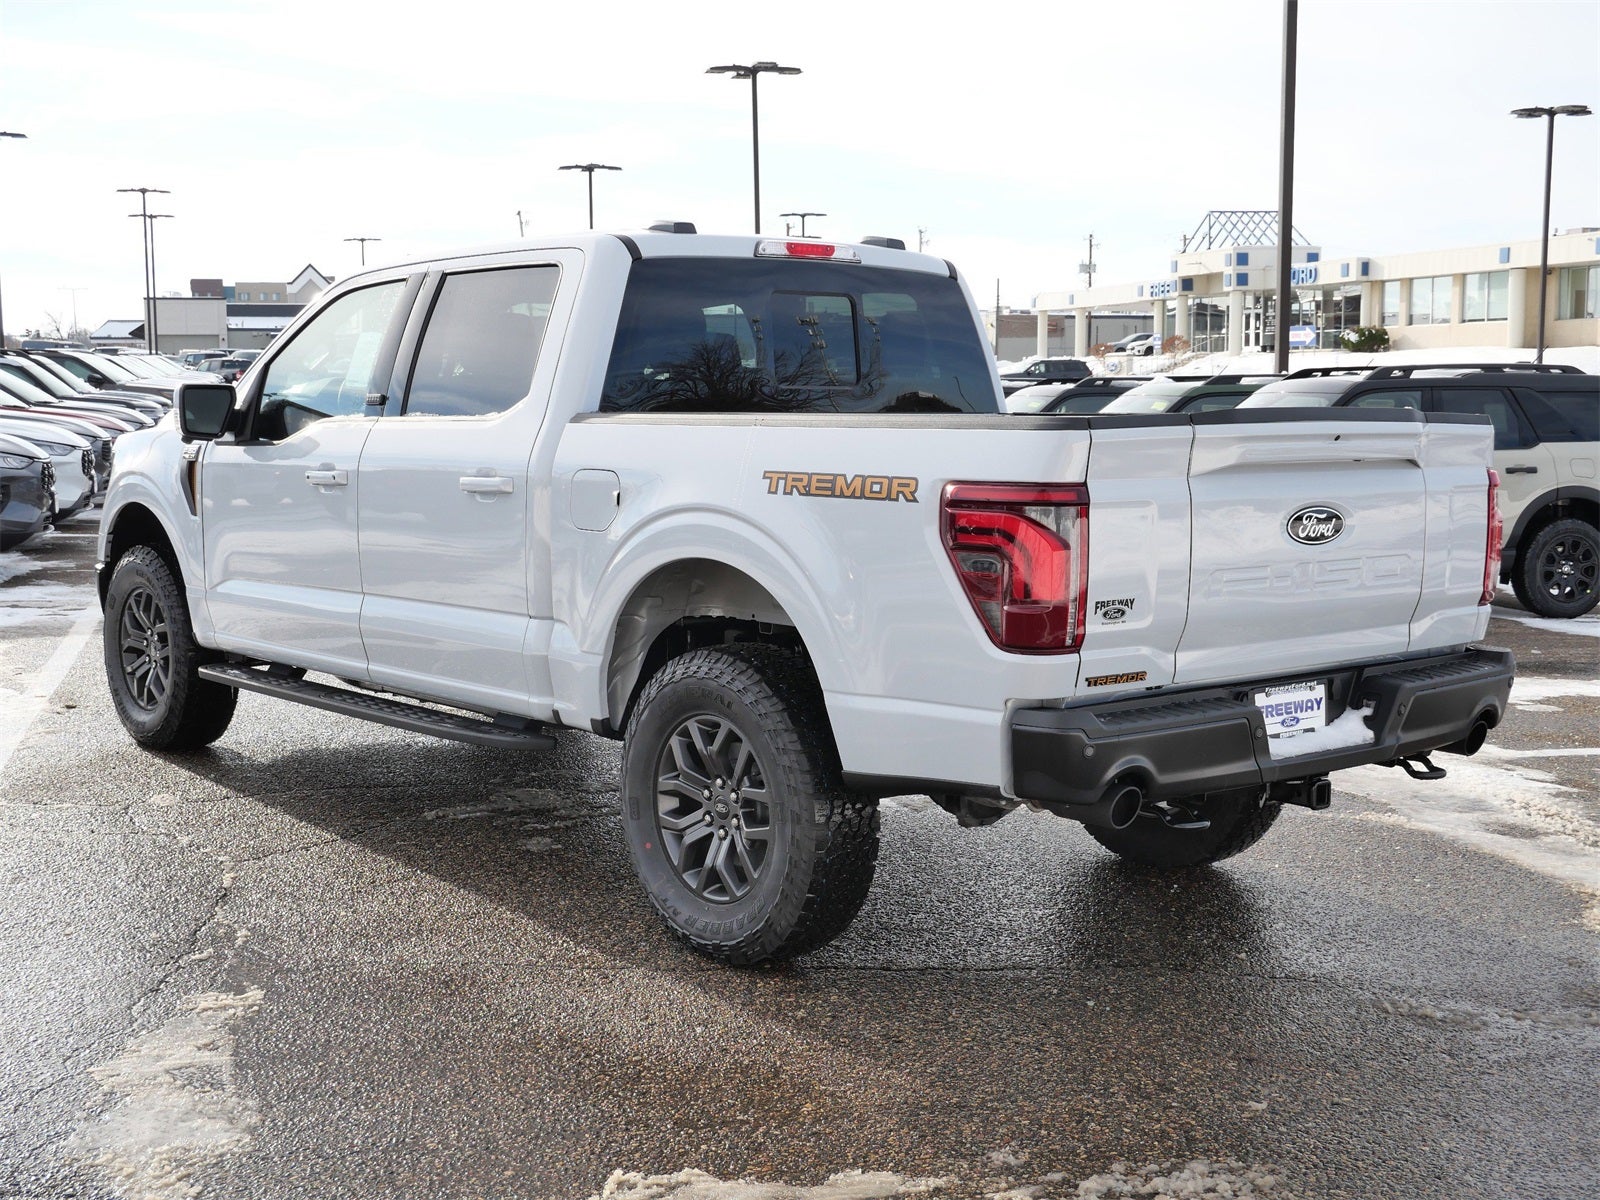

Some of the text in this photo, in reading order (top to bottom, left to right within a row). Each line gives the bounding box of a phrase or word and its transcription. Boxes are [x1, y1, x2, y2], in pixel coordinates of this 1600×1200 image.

[1291, 266, 1317, 285] ORD
[1149, 281, 1171, 298] FREE
[762, 470, 919, 503] TREMOR
[1298, 512, 1336, 538] Ford
[1094, 598, 1135, 615] FREEWAY
[1105, 609, 1123, 619] Ford
[1085, 671, 1147, 687] TREMOR
[1283, 717, 1299, 727] Ford
